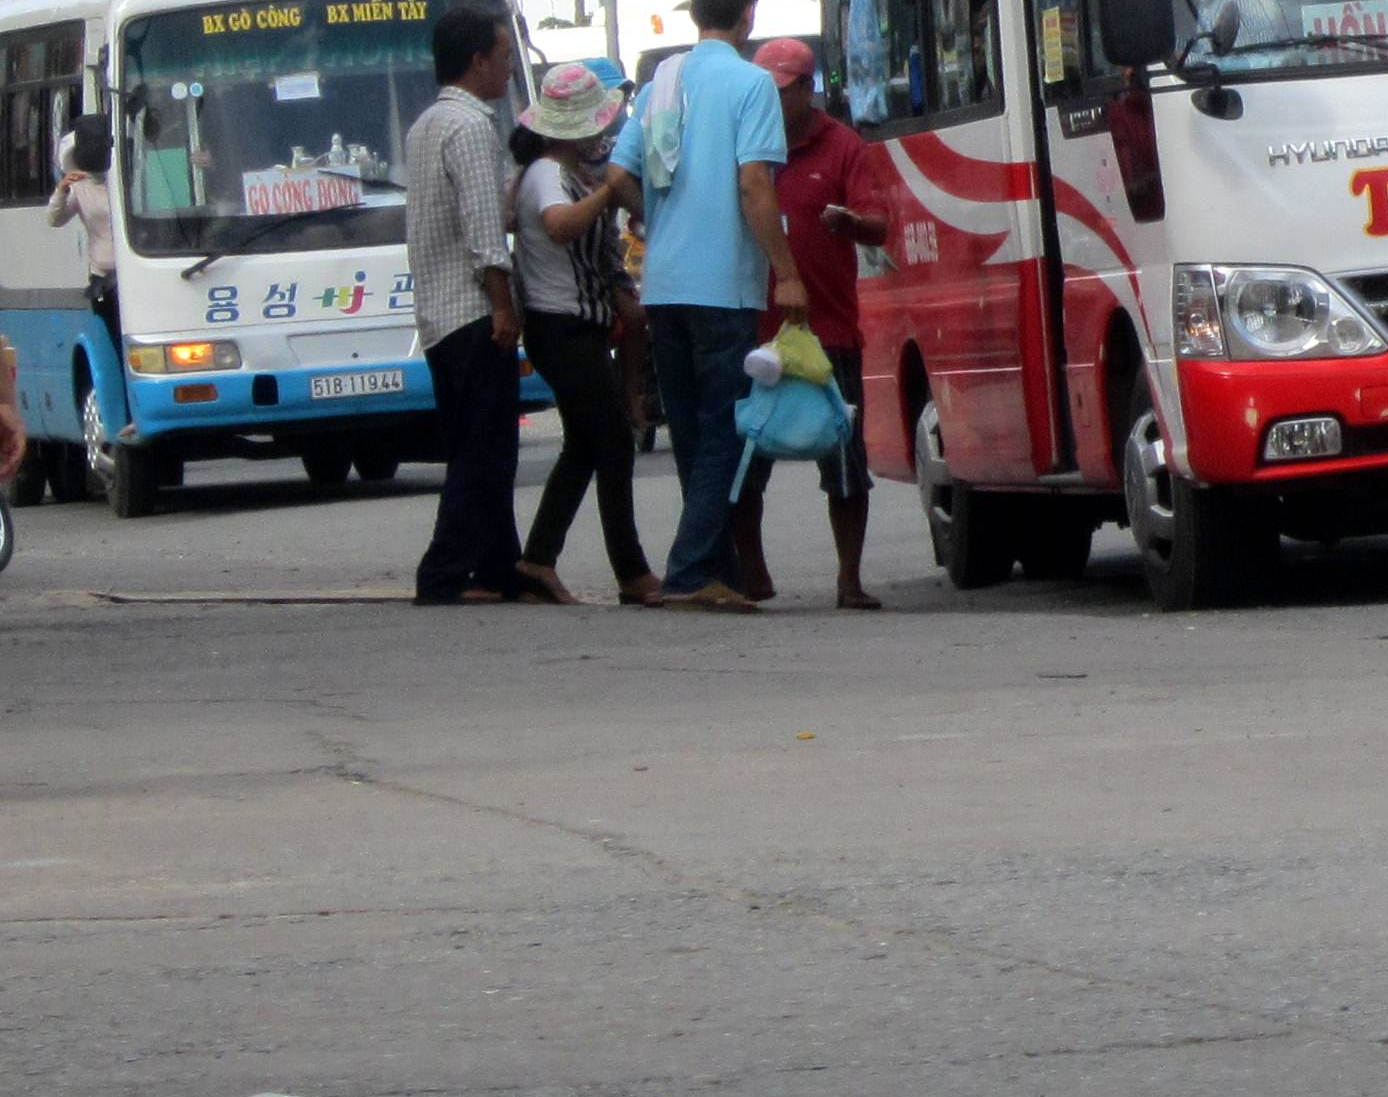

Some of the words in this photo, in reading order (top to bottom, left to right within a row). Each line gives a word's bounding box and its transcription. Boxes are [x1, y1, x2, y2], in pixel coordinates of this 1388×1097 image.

[202, 14, 226, 35] BX
[228, 7, 251, 31] GÒ
[255, 4, 301, 28] CÔNG
[326, 4, 350, 25] BX
